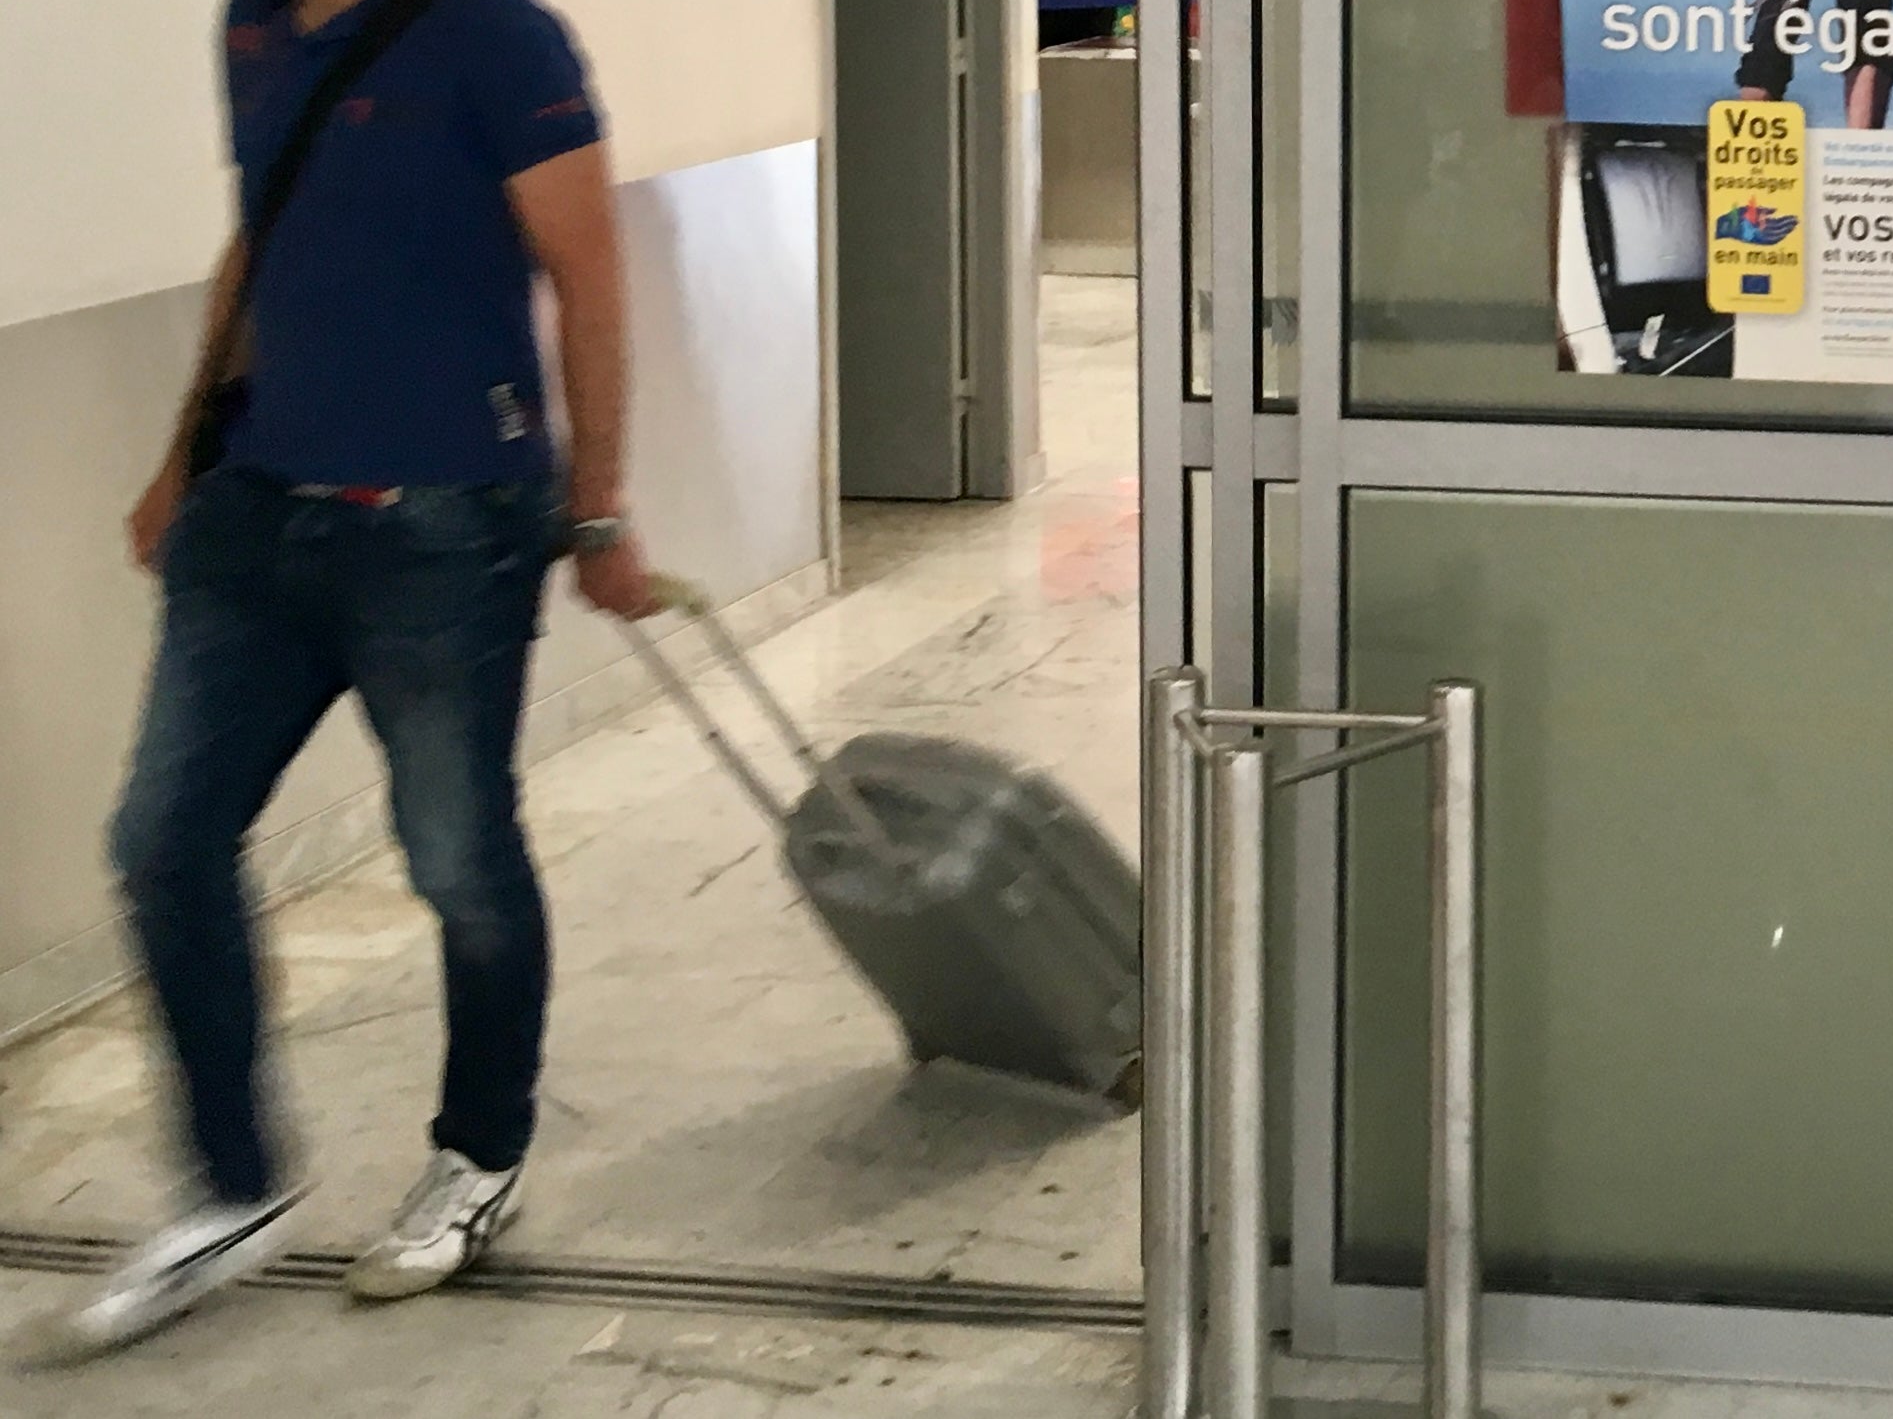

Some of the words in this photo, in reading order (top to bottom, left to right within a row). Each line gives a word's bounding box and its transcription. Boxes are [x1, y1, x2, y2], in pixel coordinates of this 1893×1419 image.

[1725, 108, 1789, 140] Vos
[1715, 141, 1799, 165] droits
[1714, 176, 1797, 193] passager
[1714, 249, 1740, 264] en
[1746, 248, 1798, 266] main
[1823, 248, 1840, 263] et
[1847, 251, 1877, 263] vos
